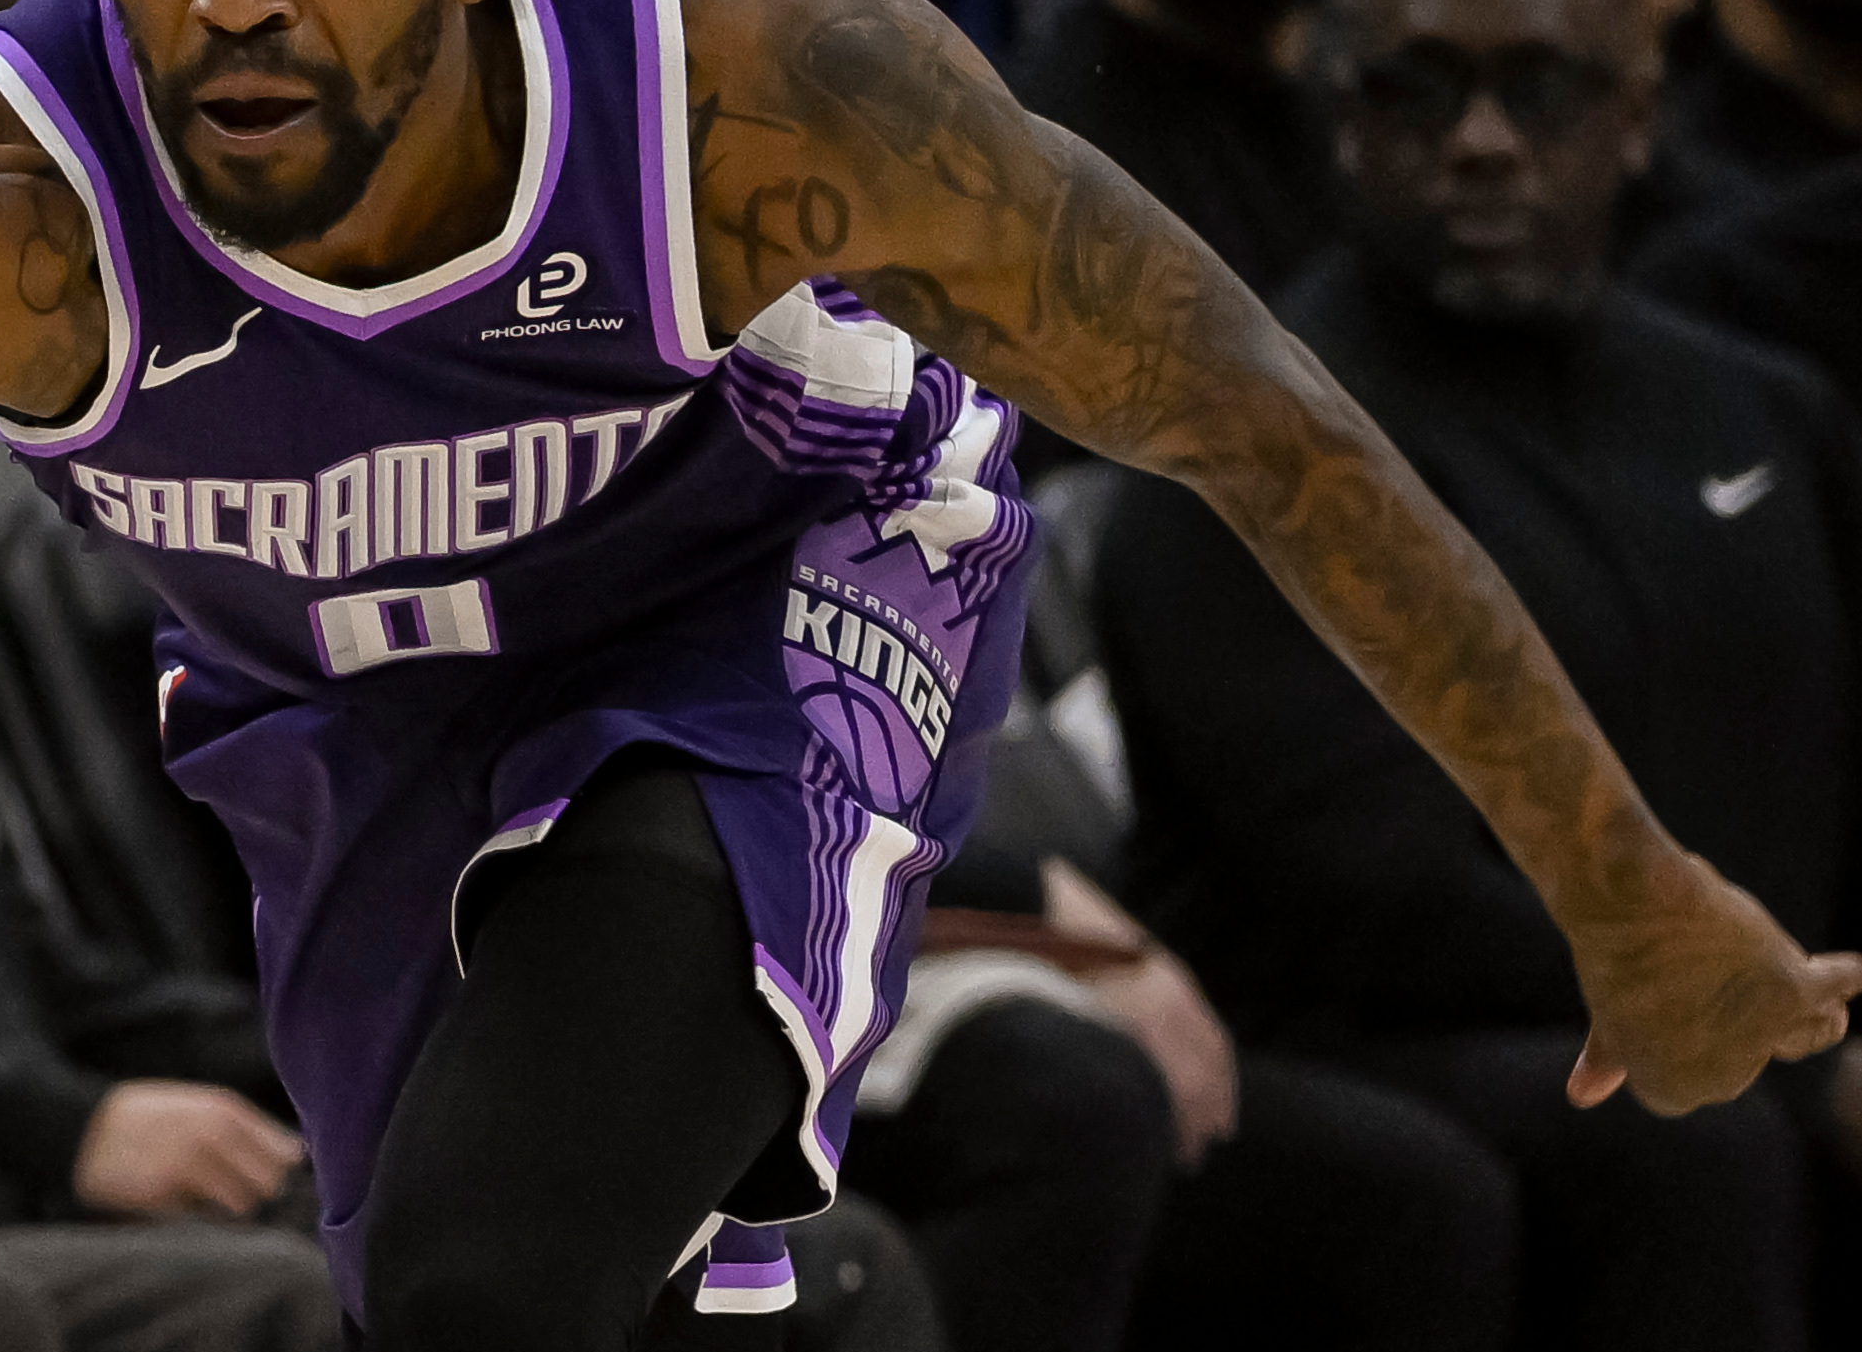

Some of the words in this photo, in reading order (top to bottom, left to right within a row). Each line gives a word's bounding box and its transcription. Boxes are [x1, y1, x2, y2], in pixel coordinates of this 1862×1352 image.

[480, 318, 572, 342] PHOONG
[576, 317, 625, 331] LAW
[308, 576, 501, 679] 0
[782, 587, 953, 761] KINGS
[797, 563, 959, 694] SACRAMENTO
